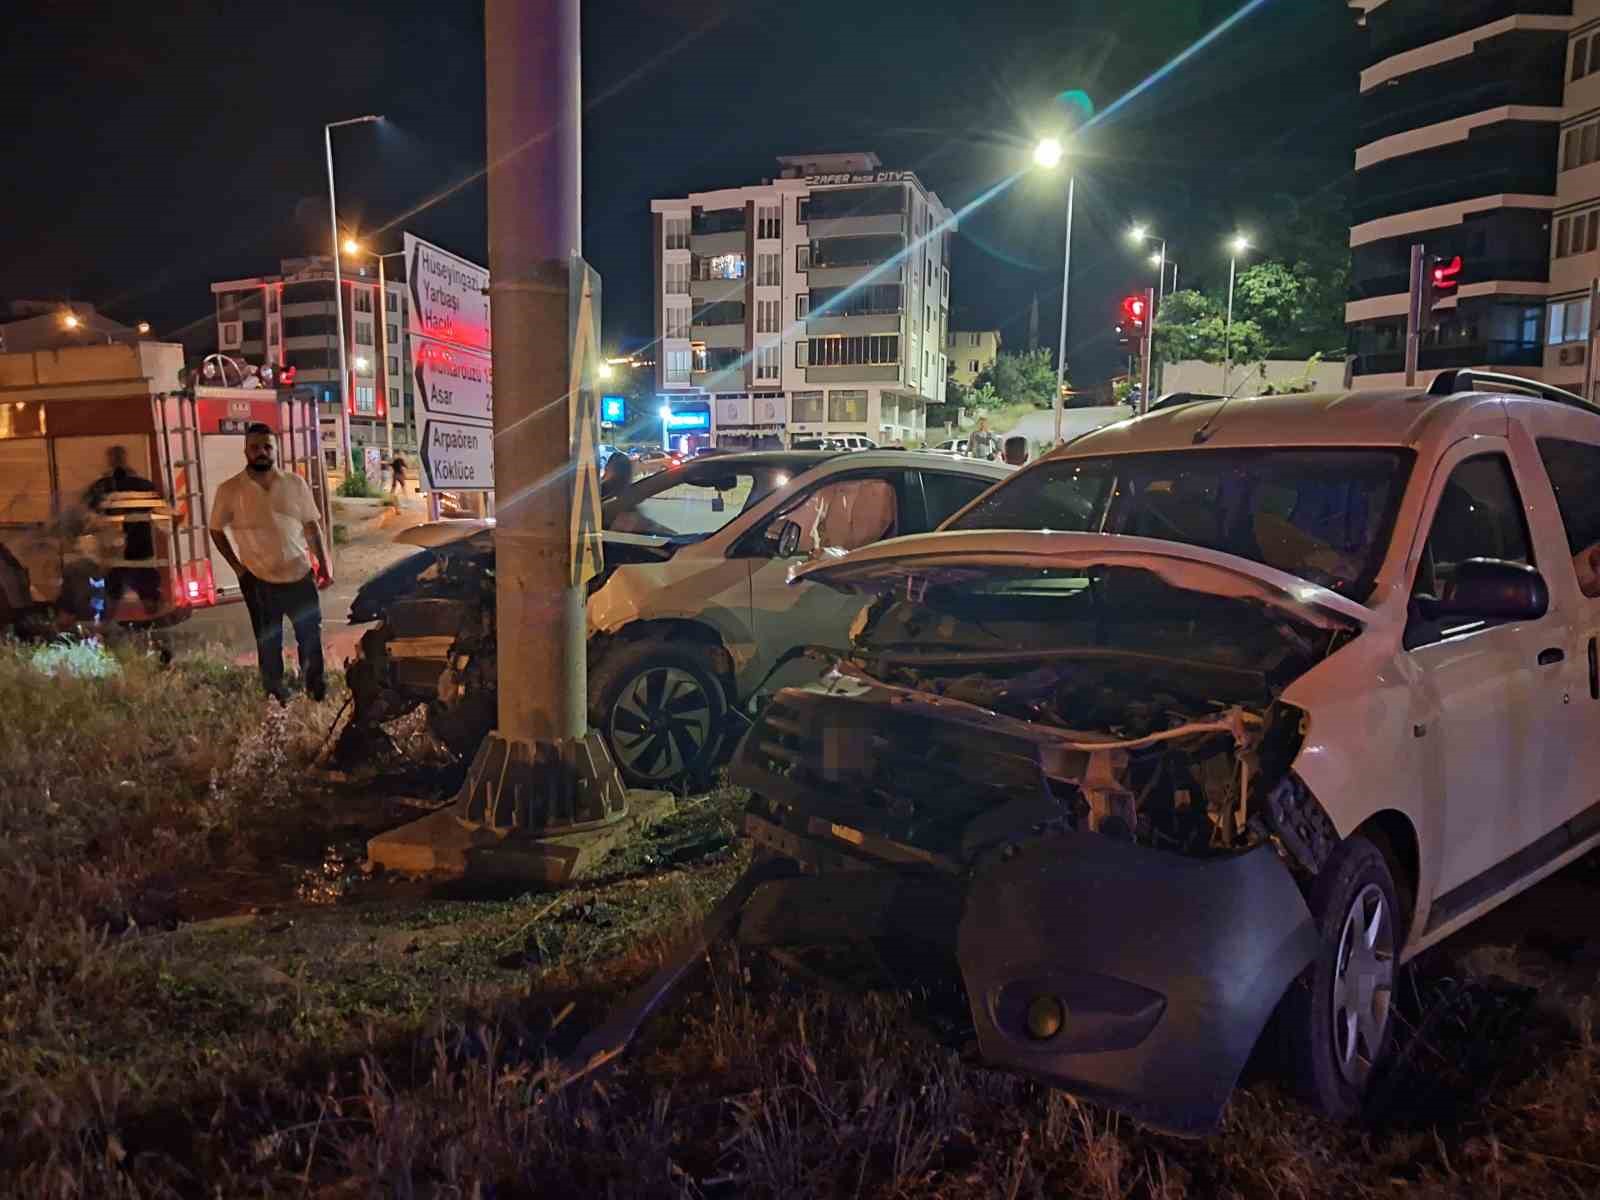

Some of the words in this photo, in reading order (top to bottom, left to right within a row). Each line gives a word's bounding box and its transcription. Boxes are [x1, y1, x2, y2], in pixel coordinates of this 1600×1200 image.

[878, 171, 903, 182] CITY
[423, 251, 480, 293] Hüseyingazi
[424, 280, 460, 315] Yarbaşı
[430, 383, 453, 404] Asar
[433, 427, 479, 453] Arpaören
[434, 459, 475, 481] Köklüce
